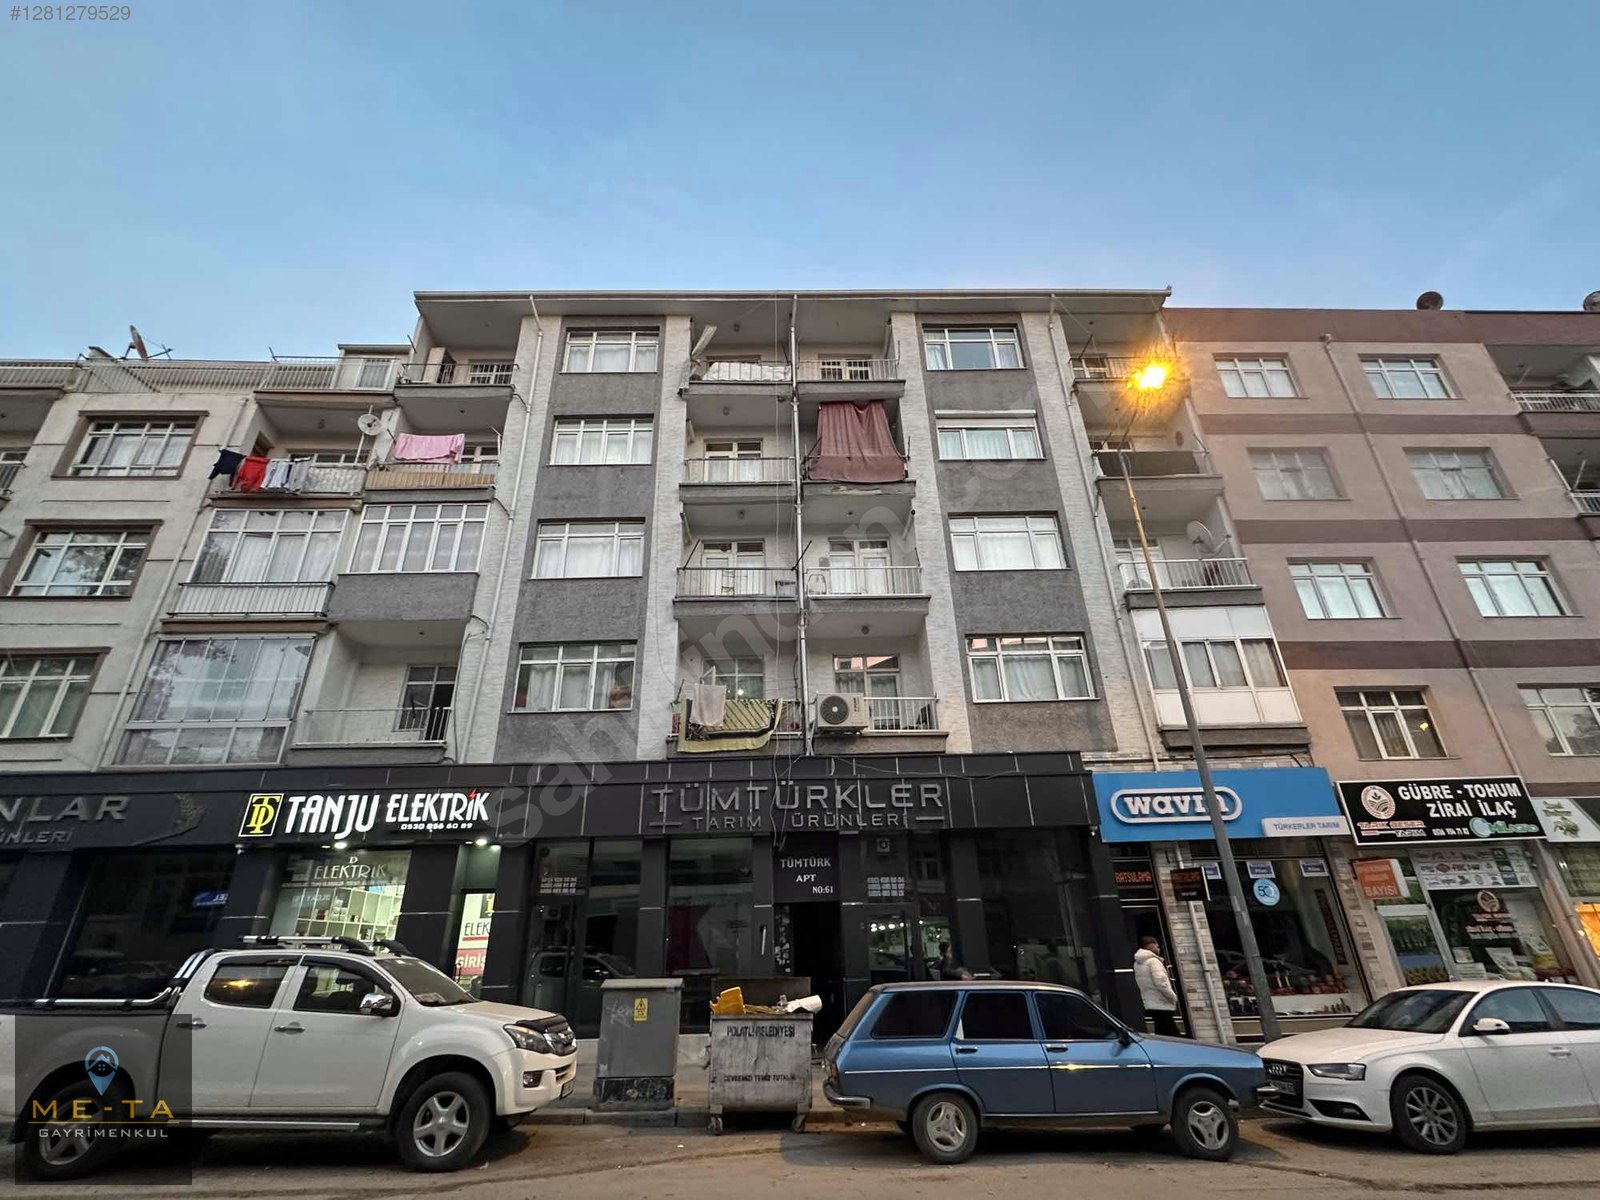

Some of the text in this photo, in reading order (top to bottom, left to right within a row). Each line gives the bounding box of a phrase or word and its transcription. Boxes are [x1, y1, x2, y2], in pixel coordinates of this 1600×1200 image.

[651, 780, 944, 813] TÜMTÜRKLER
[1398, 783, 1454, 800] GÜBRE
[1463, 783, 1522, 798] TOHUM
[285, 794, 381, 840] TANJU
[692, 815, 763, 830] TARIM
[780, 857, 831, 869] TÜMTÜRK
[796, 874, 817, 883] APT
[812, 886, 834, 894] NO:61
